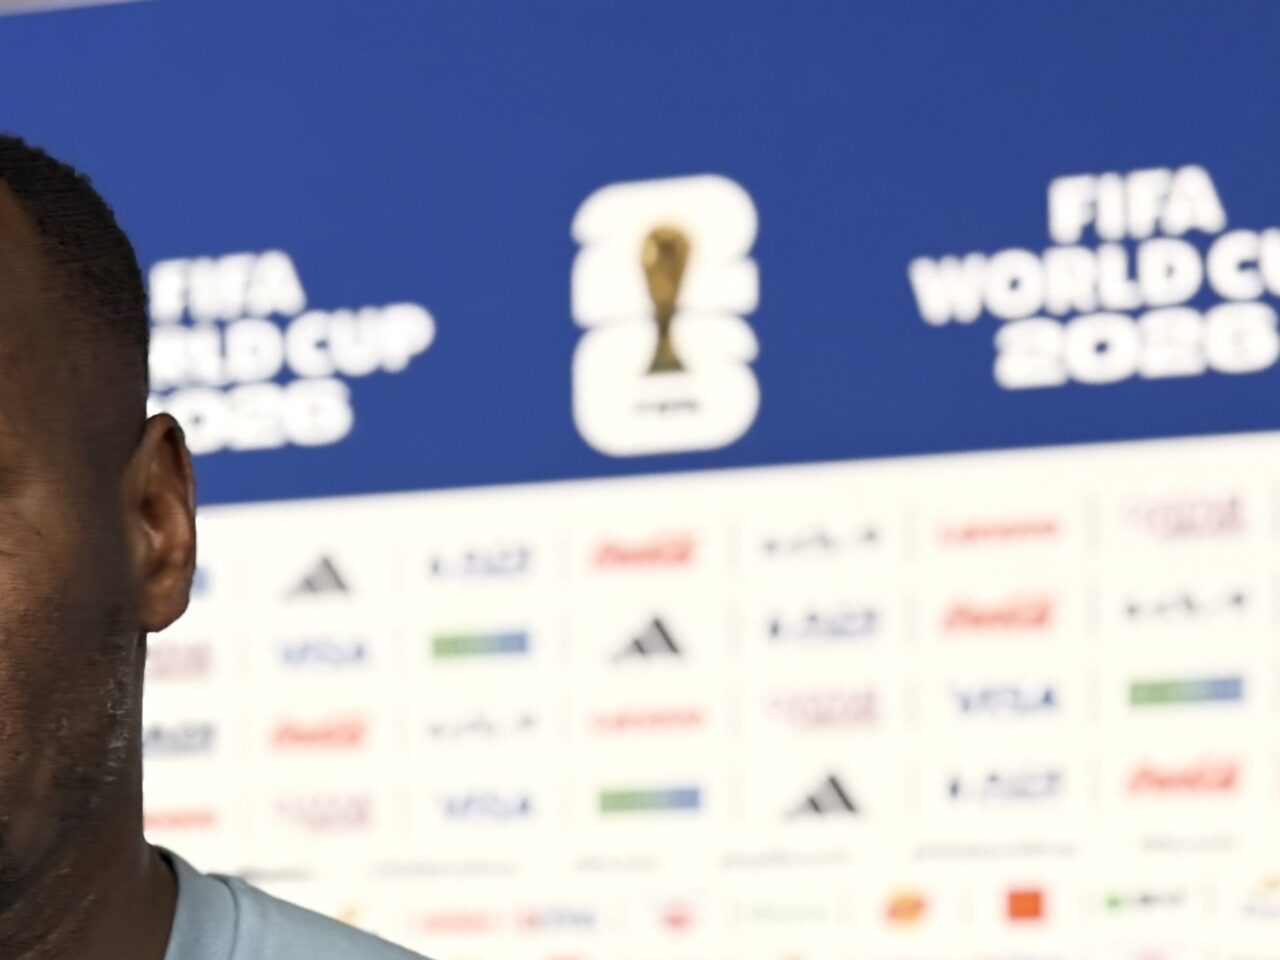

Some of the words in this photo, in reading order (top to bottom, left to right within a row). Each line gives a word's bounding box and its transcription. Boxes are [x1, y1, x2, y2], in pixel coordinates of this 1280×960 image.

[1048, 164, 1227, 245] FIFA
[148, 249, 308, 325] FIFA
[907, 236, 1205, 327] WORLD
[146, 317, 284, 391] RLD
[283, 302, 435, 378] CUP
[993, 300, 1280, 391] 2026
[145, 376, 354, 456] 026
